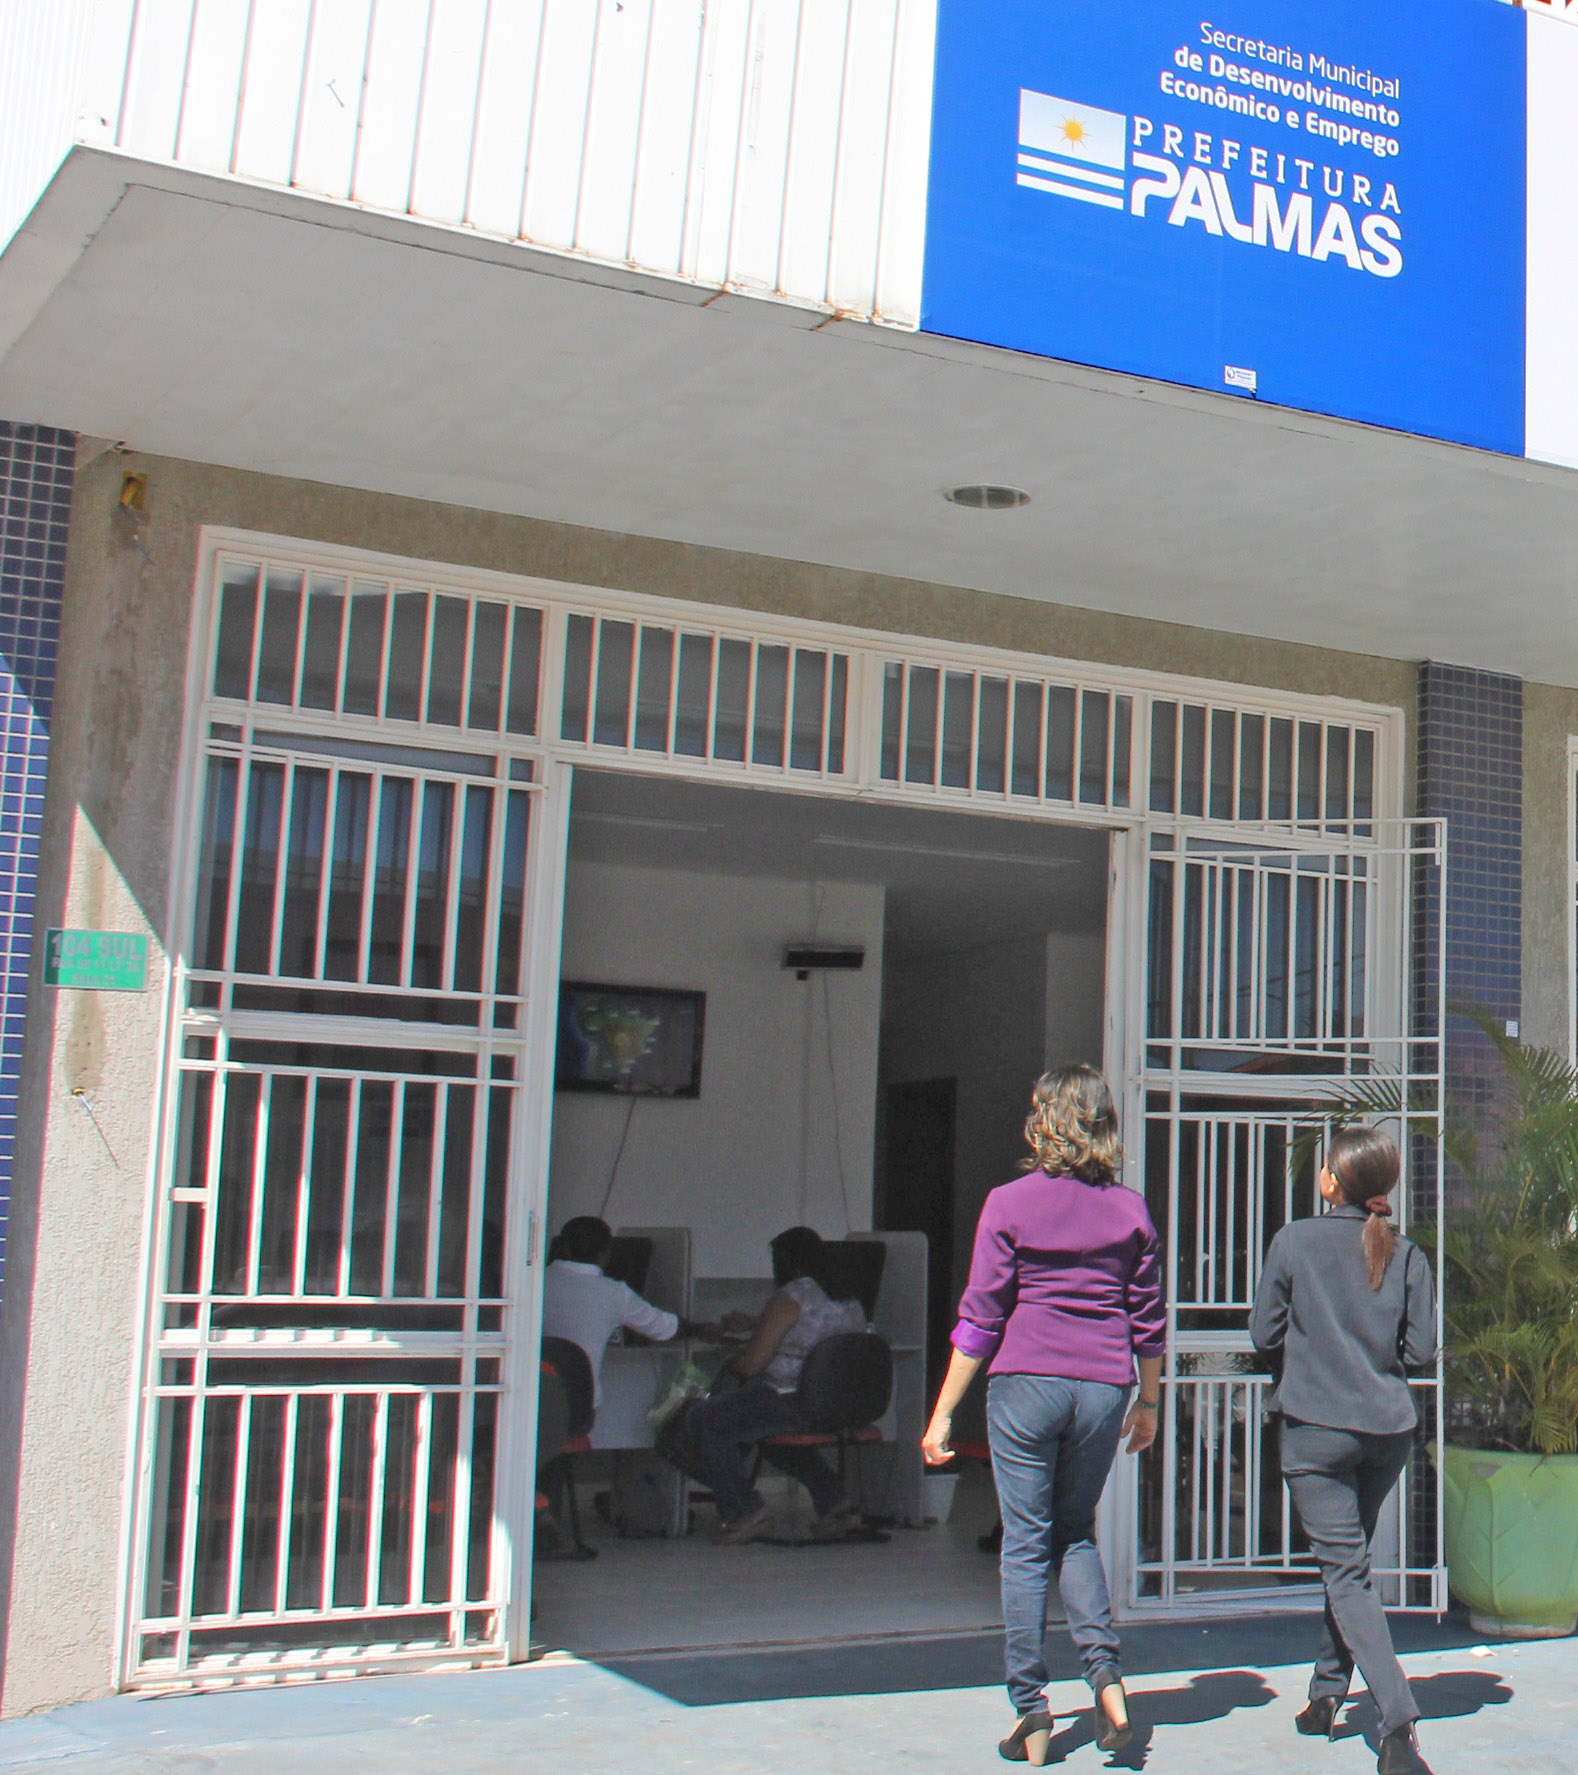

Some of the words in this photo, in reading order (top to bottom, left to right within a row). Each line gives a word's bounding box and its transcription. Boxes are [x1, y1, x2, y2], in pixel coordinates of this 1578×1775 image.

[1174, 46, 1203, 72] de
[1210, 54, 1400, 127] Desenvolvimento
[1200, 21, 1303, 72] Secretaria
[1309, 52, 1400, 100] Municipal
[1160, 71, 1280, 123] Econômico
[1286, 110, 1299, 128] e
[1305, 111, 1399, 158] Emprego
[1133, 115, 1401, 214] PREFEITURA
[1131, 151, 1403, 278] PALMAS
[51, 933, 92, 957] 104
[98, 935, 142, 960] SUL
